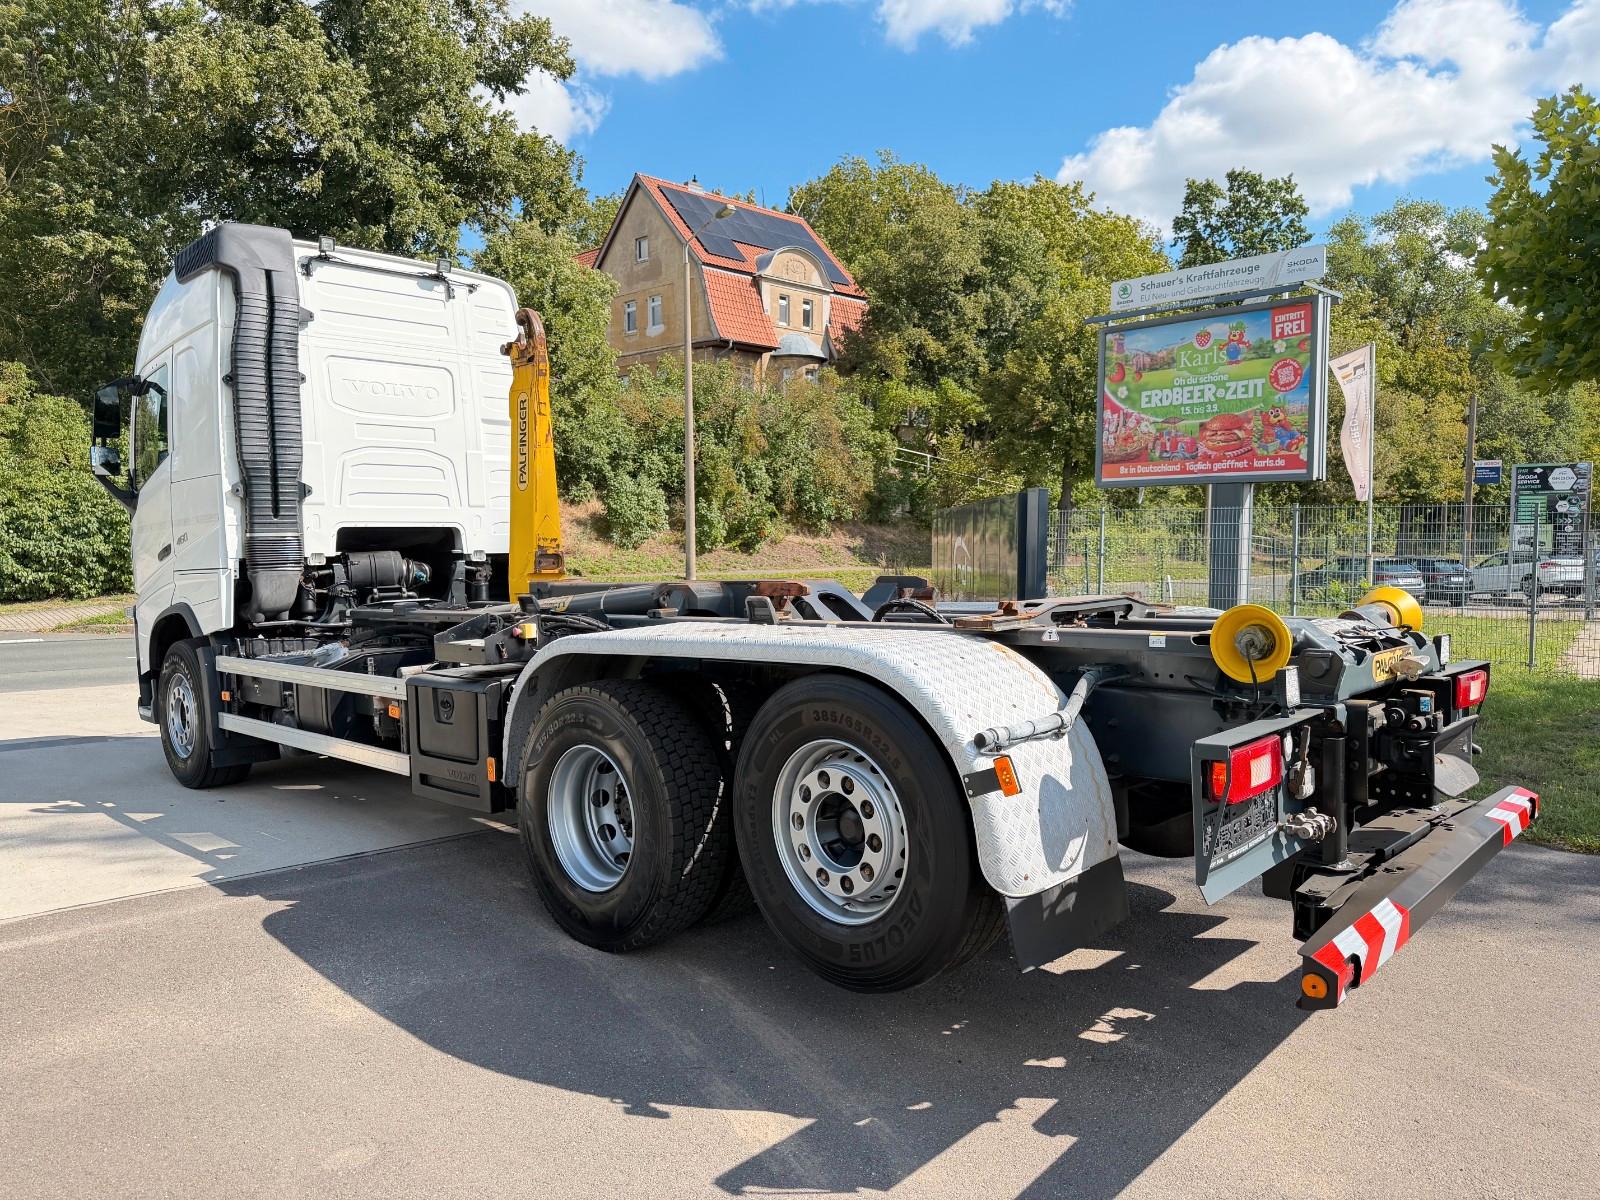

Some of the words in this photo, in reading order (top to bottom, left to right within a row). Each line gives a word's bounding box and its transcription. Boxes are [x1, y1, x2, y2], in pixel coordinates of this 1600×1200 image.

[1141, 276, 1183, 291] Schauer's
[1186, 264, 1260, 283] Kraftfahrzeuge
[1172, 286, 1186, 297] und
[1187, 276, 1265, 294] Gebrauchtfahrzeuge
[1274, 311, 1306, 323] EINTRITT
[1275, 320, 1305, 338] FREI
[1179, 346, 1227, 368] Karls
[343, 378, 440, 400] VOLVO
[1174, 377, 1185, 386] Oh
[1187, 376, 1197, 385] du
[1200, 373, 1229, 383] schöne
[1141, 384, 1216, 408] ERDBEER
[1225, 378, 1266, 400] ZEIT
[1193, 405, 1205, 414] bis
[518, 398, 527, 484] PALFINGER
[1129, 465, 1136, 474] in
[1137, 462, 1181, 474] Deutschland
[1186, 461, 1211, 473] Täglich
[1212, 460, 1248, 472] geöffnet
[1253, 457, 1286, 467] karls.de
[812, 709, 902, 770] 385/65R22.5
